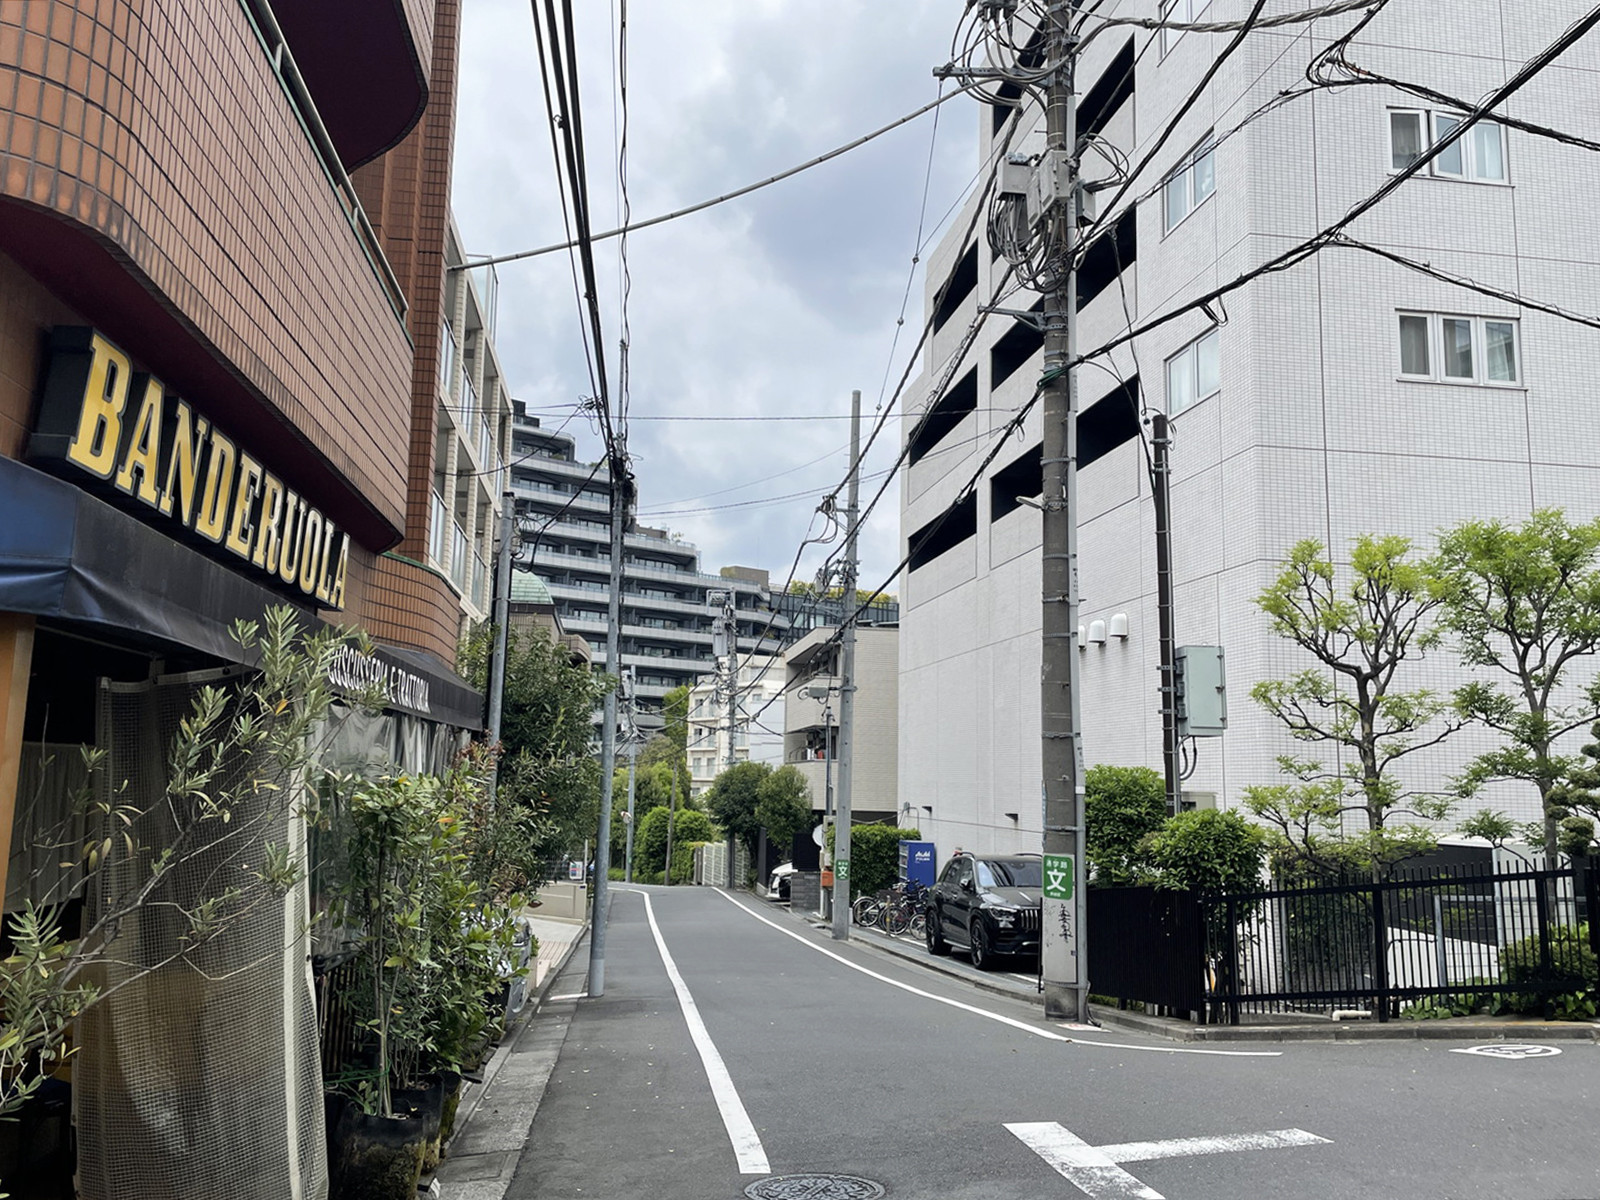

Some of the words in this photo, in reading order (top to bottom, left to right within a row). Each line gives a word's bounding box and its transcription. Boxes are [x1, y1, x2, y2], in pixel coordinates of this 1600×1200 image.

[66, 331, 351, 610] BANDERUOLA
[398, 669, 431, 713] TRATTORIA
[1046, 868, 1066, 892] 文
